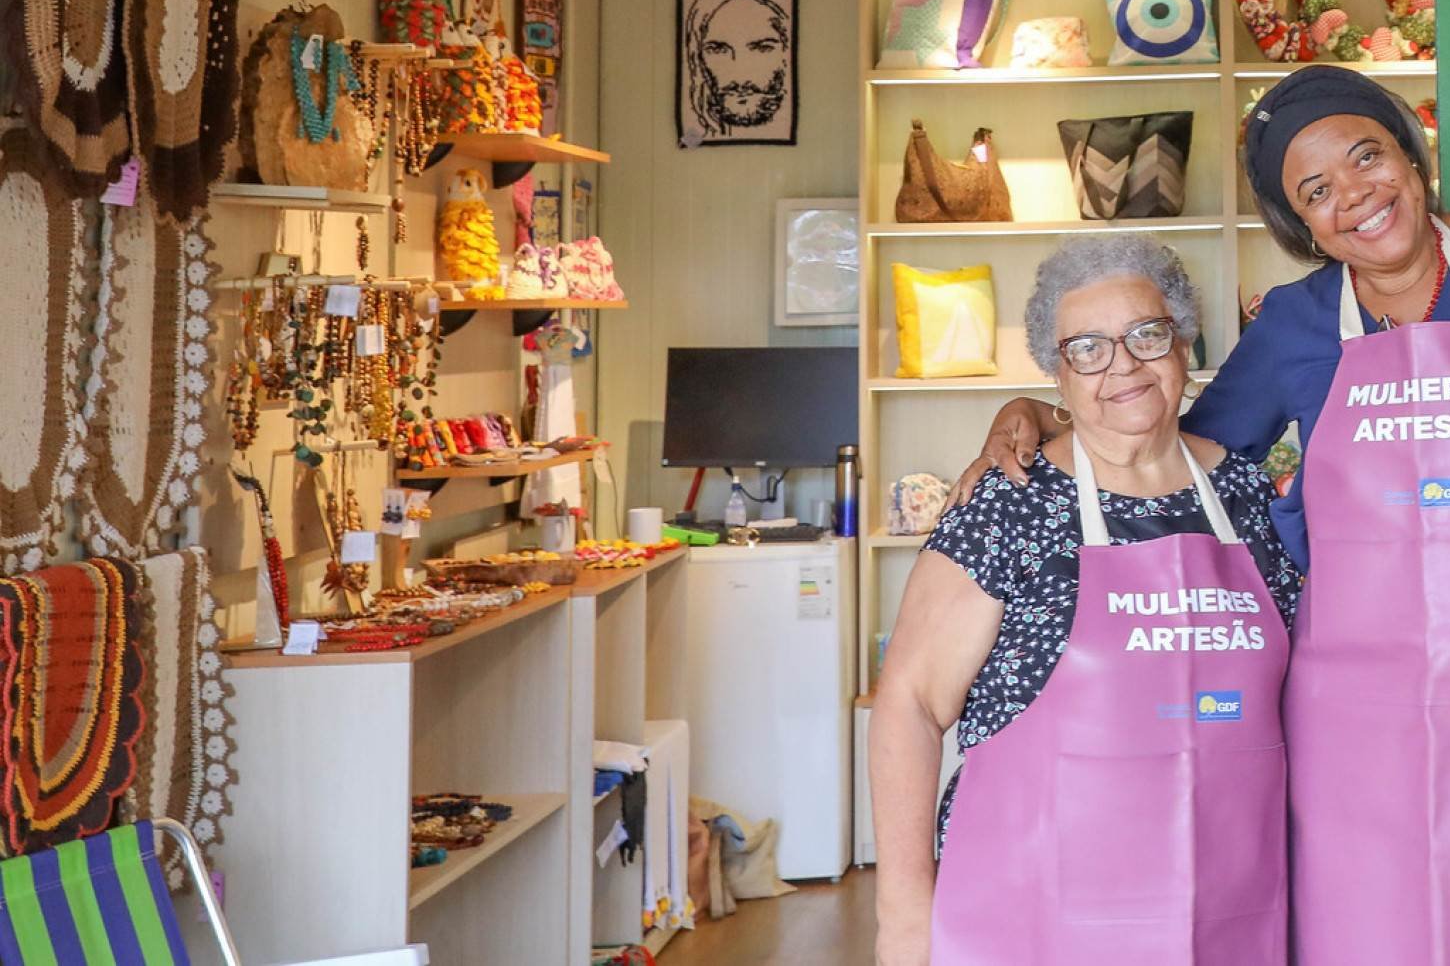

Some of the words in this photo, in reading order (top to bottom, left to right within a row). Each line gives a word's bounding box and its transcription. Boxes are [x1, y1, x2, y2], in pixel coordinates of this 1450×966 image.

[1106, 587, 1261, 616] MULHERES
[1124, 619, 1265, 652] ARTESÃS
[1216, 701, 1241, 713] GDF
